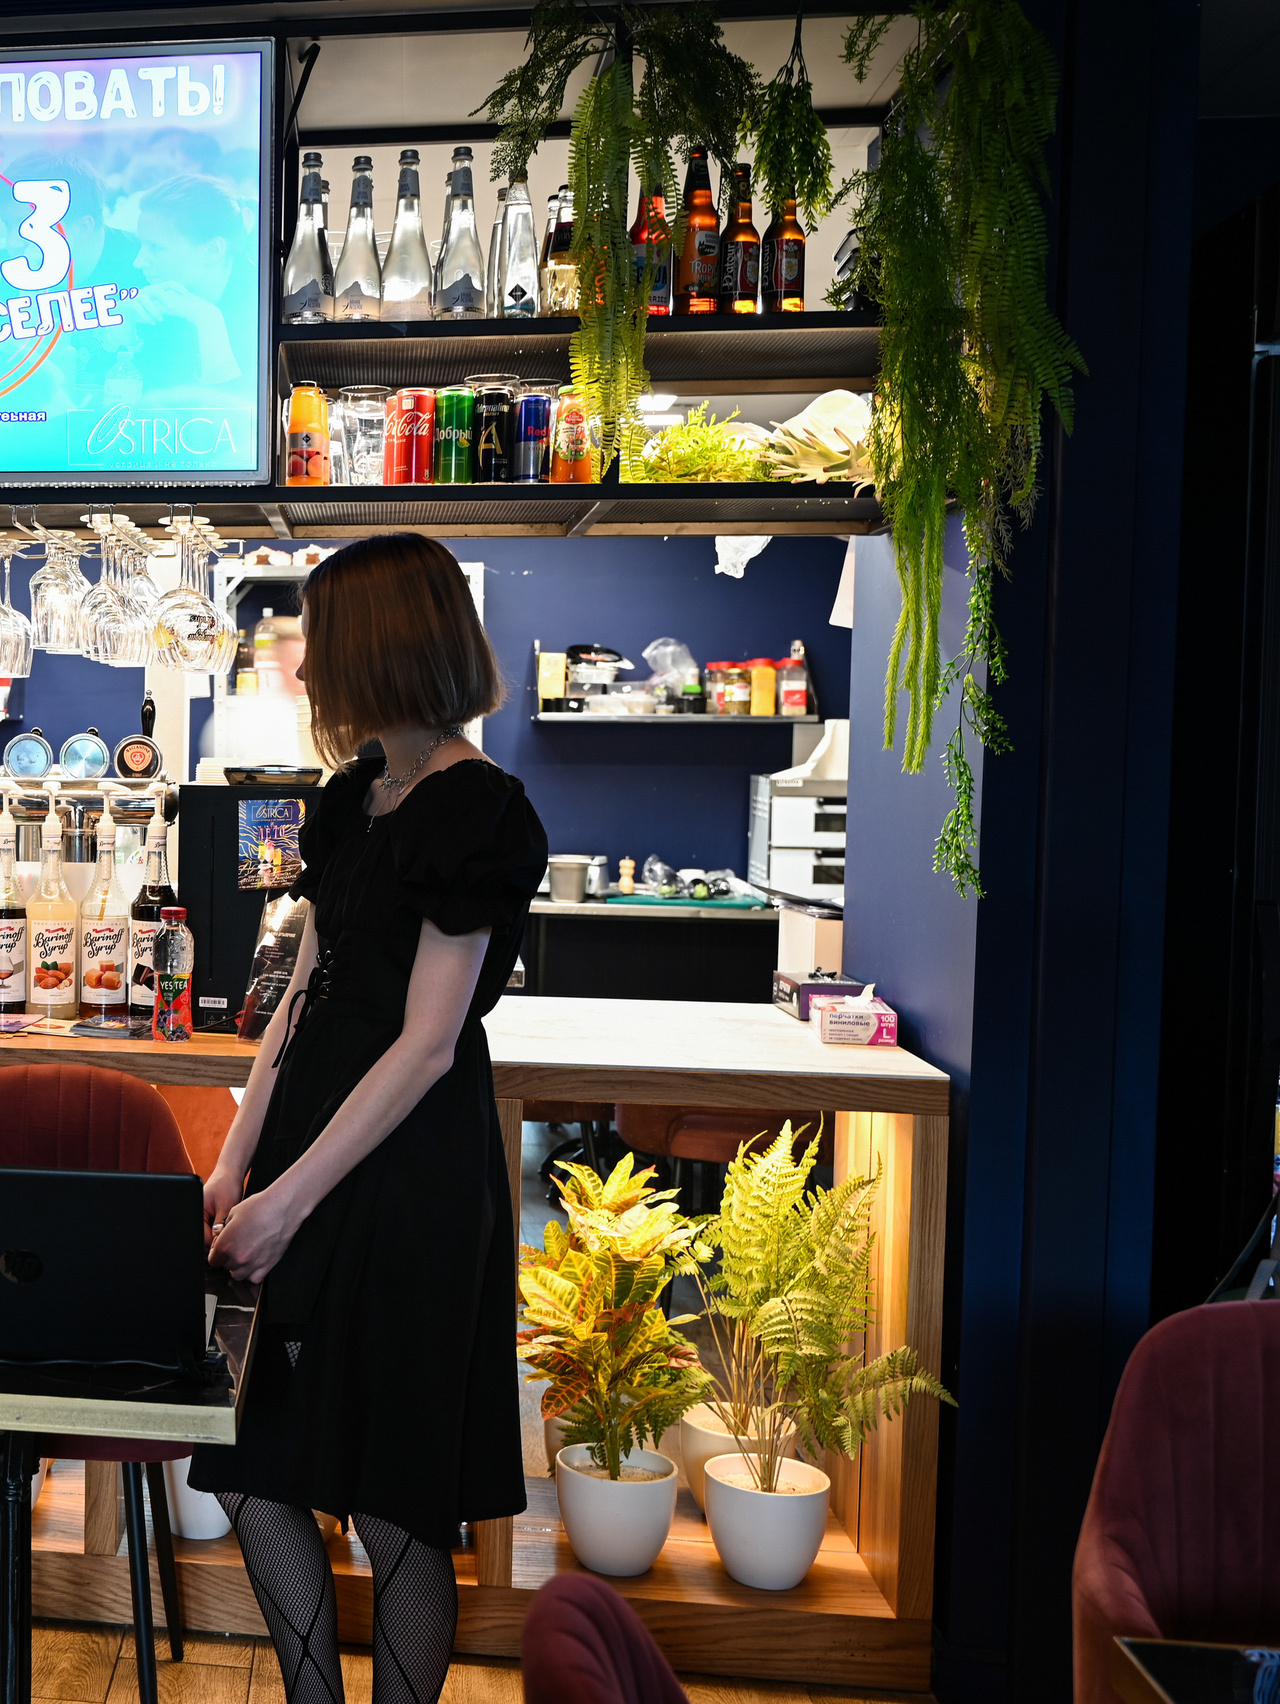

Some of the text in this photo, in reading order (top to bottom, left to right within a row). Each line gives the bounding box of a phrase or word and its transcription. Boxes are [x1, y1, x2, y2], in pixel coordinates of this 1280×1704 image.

[527, 426, 546, 436] Red
[33, 927, 74, 948] Barinoff
[83, 928, 124, 947] Barinoff
[39, 942, 68, 959] Syrup
[88, 942, 116, 958] Syrup
[160, 980, 188, 990] YES TEA
[883, 1028, 891, 1039] L
